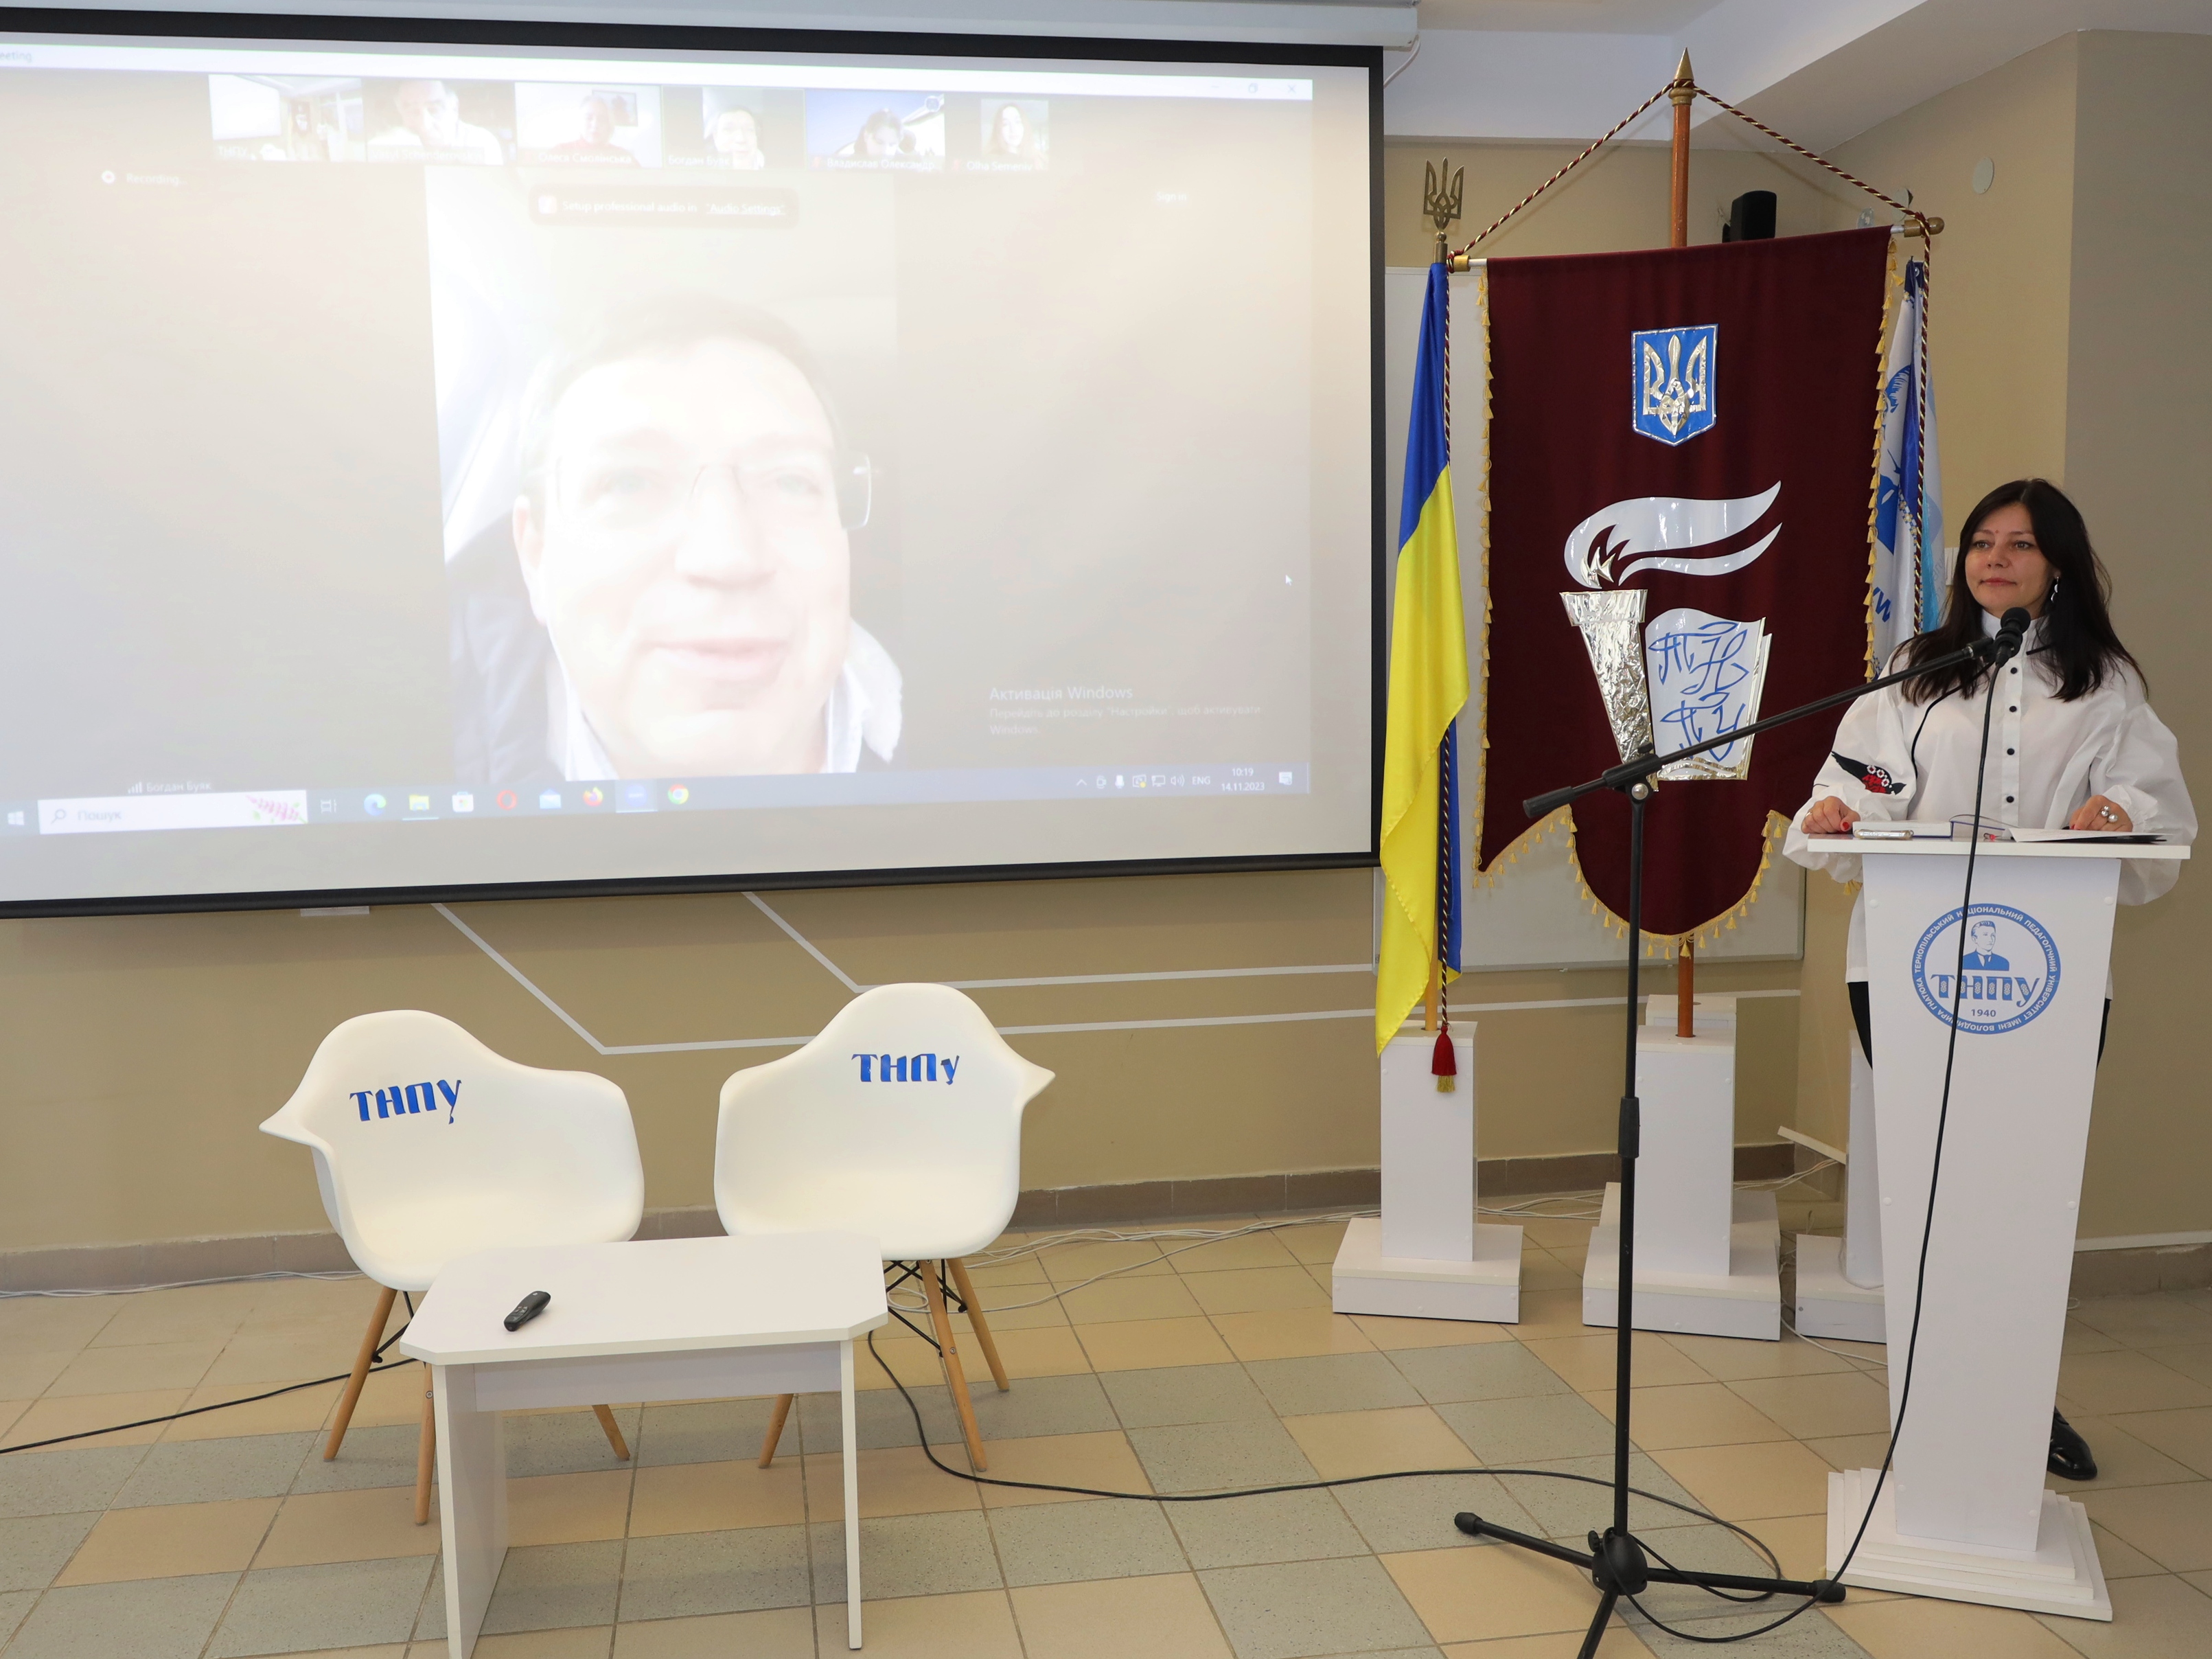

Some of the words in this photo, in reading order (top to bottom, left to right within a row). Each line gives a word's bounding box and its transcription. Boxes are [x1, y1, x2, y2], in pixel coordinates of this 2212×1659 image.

[573, 153, 632, 164] Смолінська
[669, 155, 704, 167] Богдан
[827, 157, 878, 169] Владислав
[967, 160, 989, 171] Olha
[1156, 191, 1177, 203] Sign
[1178, 192, 1188, 202] in
[562, 201, 591, 212] Setup
[594, 201, 655, 214] professional
[658, 203, 686, 213] audio
[688, 203, 698, 213] in
[989, 688, 1063, 702] Активація
[1067, 685, 1133, 700] Windows
[1177, 705, 1201, 716] щоб
[1203, 706, 1260, 716] активувати
[1232, 768, 1254, 777] 10:19
[146, 781, 184, 792] Богдан
[186, 780, 212, 793] Буяк
[1192, 776, 1211, 786] ENG
[1221, 781, 1265, 791] 14.11.2023
[77, 810, 122, 823] Пошук
[1956, 906, 2024, 922] НЦІОНАЛЬНИЙ
[1914, 913, 1955, 973] ТЕРНОПІЛЬСЬКИЙ
[2023, 919, 2058, 972] ПЕДАГОГІЧНИЙ
[1916, 976, 1937, 1010] ГНАТЮКА
[1930, 974, 2040, 1007] ТНПУ
[2024, 974, 2055, 1020] УНІВЕРСИТЕТ
[1971, 1009, 1996, 1017] 1940
[1998, 1016, 2022, 1031] ІМЕНІ
[851, 1053, 960, 1085] ТНПУ
[349, 1079, 462, 1125] ТНПУ
